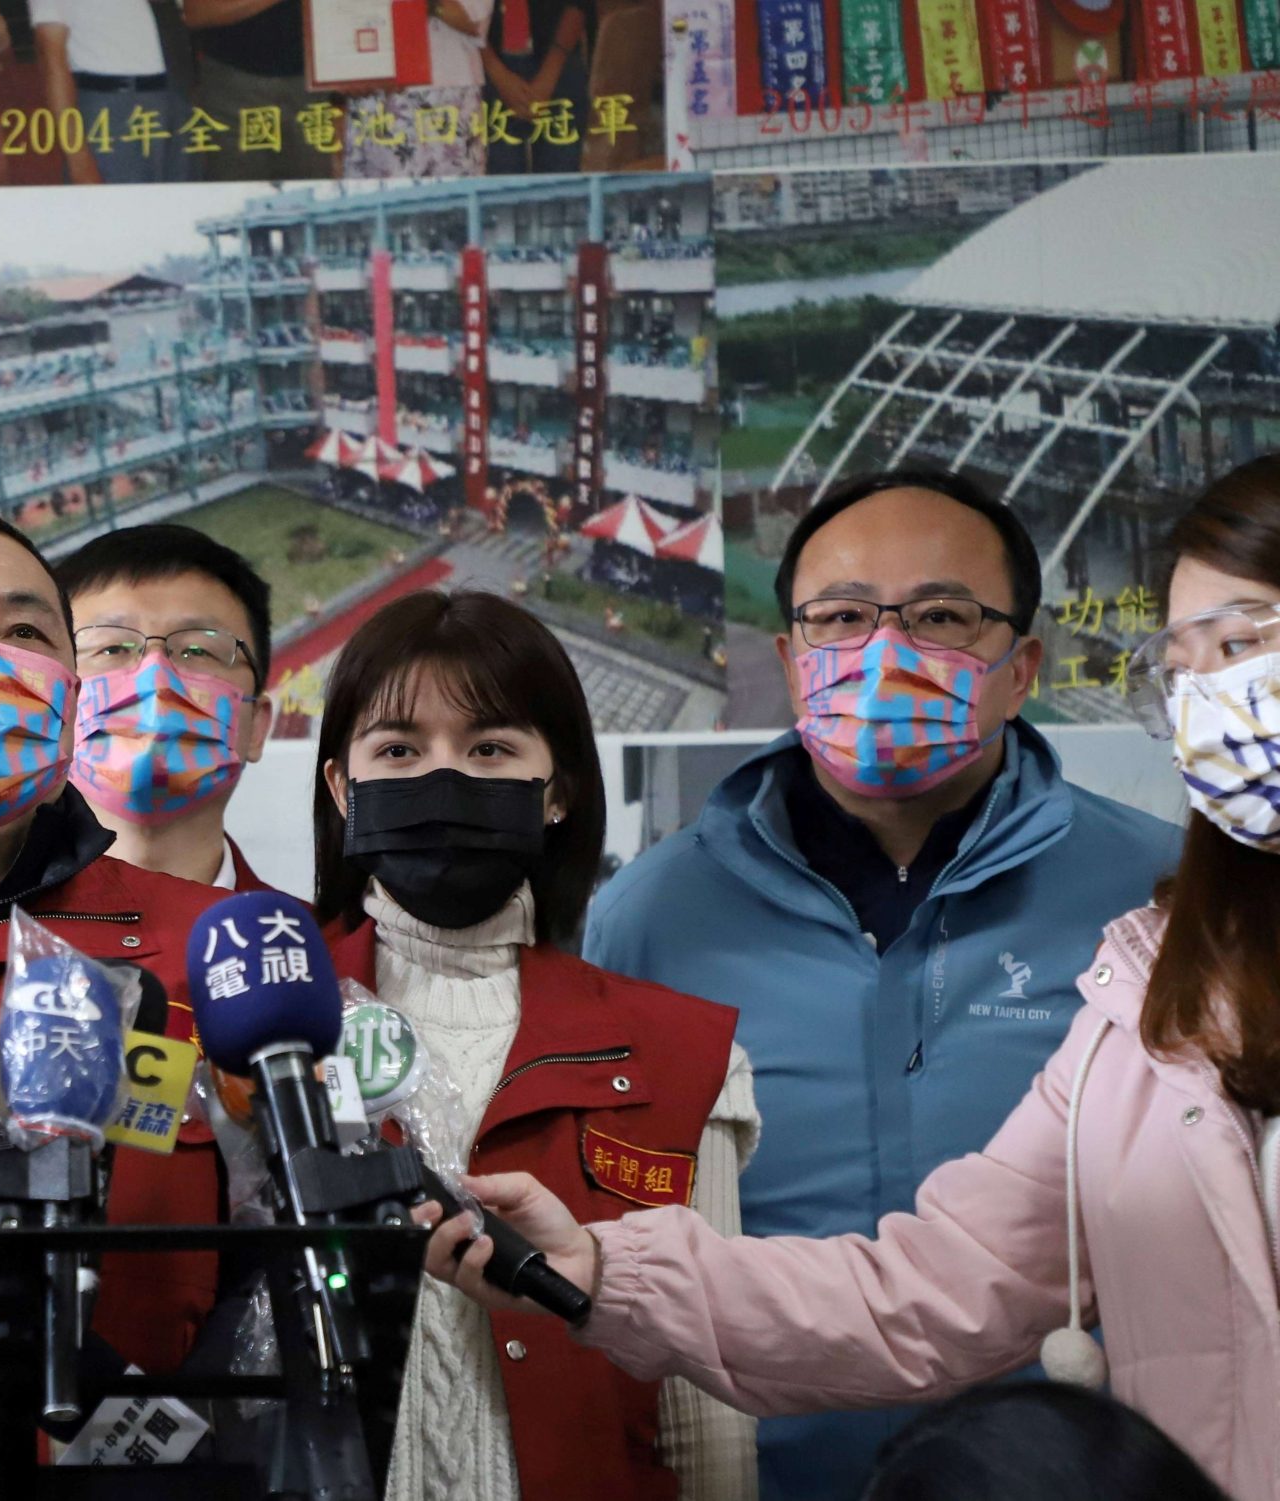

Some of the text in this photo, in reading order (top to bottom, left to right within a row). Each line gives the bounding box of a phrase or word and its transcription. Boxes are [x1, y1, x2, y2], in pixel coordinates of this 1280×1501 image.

[1, 94, 639, 155] 2004年全國電池回收冠軍
[204, 909, 306, 964] 八大
[205, 946, 313, 1001] 電視
[969, 1003, 1052, 1021] NEW TAIPEI CITY
[593, 1146, 673, 1193] 新聞組
